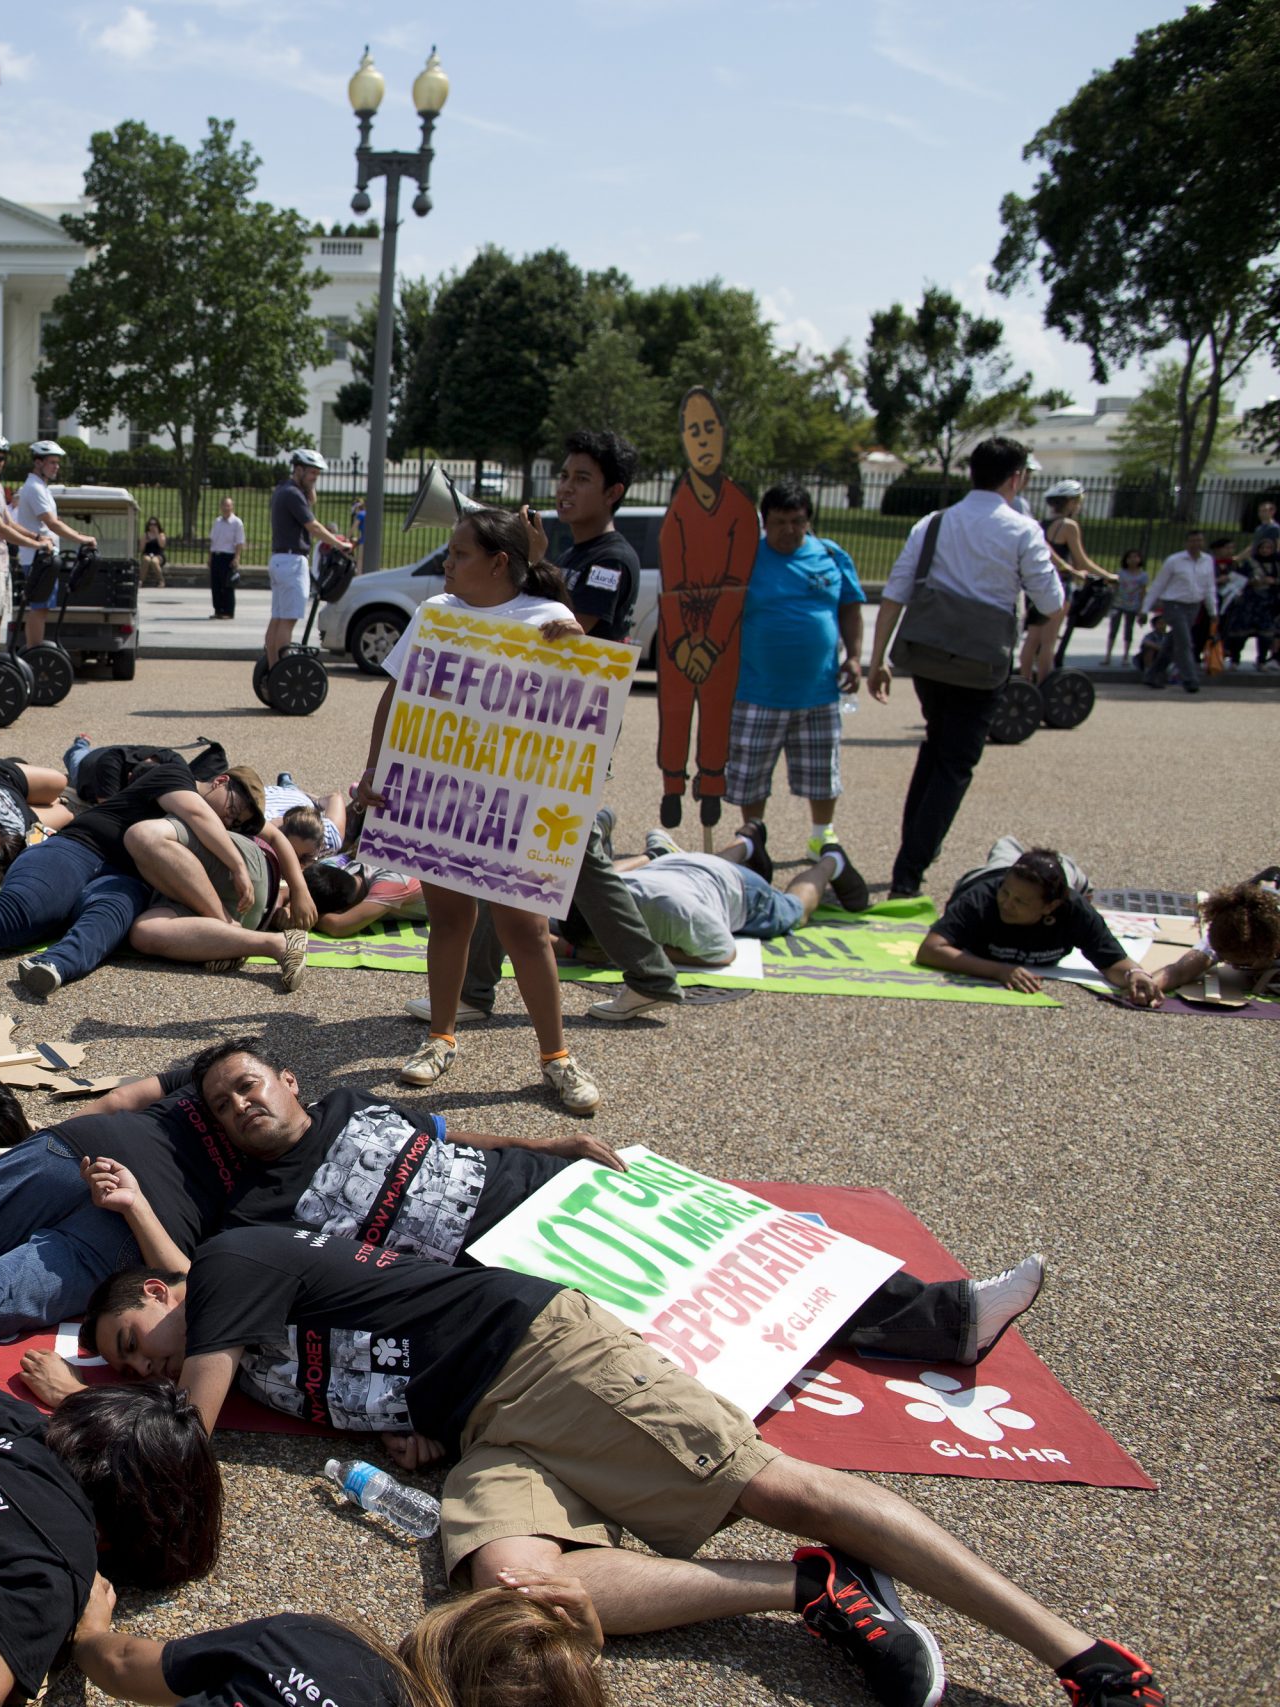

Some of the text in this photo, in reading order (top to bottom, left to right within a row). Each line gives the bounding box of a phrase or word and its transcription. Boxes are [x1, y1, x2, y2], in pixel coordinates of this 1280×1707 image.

[401, 645, 610, 736] REFORMA
[388, 698, 598, 796] MIGRATORIA
[373, 762, 529, 854] AHORA!
[177, 1098, 208, 1133] STOP
[381, 1158, 414, 1209] MANY
[355, 1243, 376, 1264] STO
[376, 1249, 400, 1269] STO
[786, 1285, 838, 1332] GLAHR
[305, 1329, 324, 1397] MORE?
[401, 1338, 410, 1369] GLAHR
[929, 1439, 1071, 1465] GLAHR
[287, 1667, 321, 1702] We
